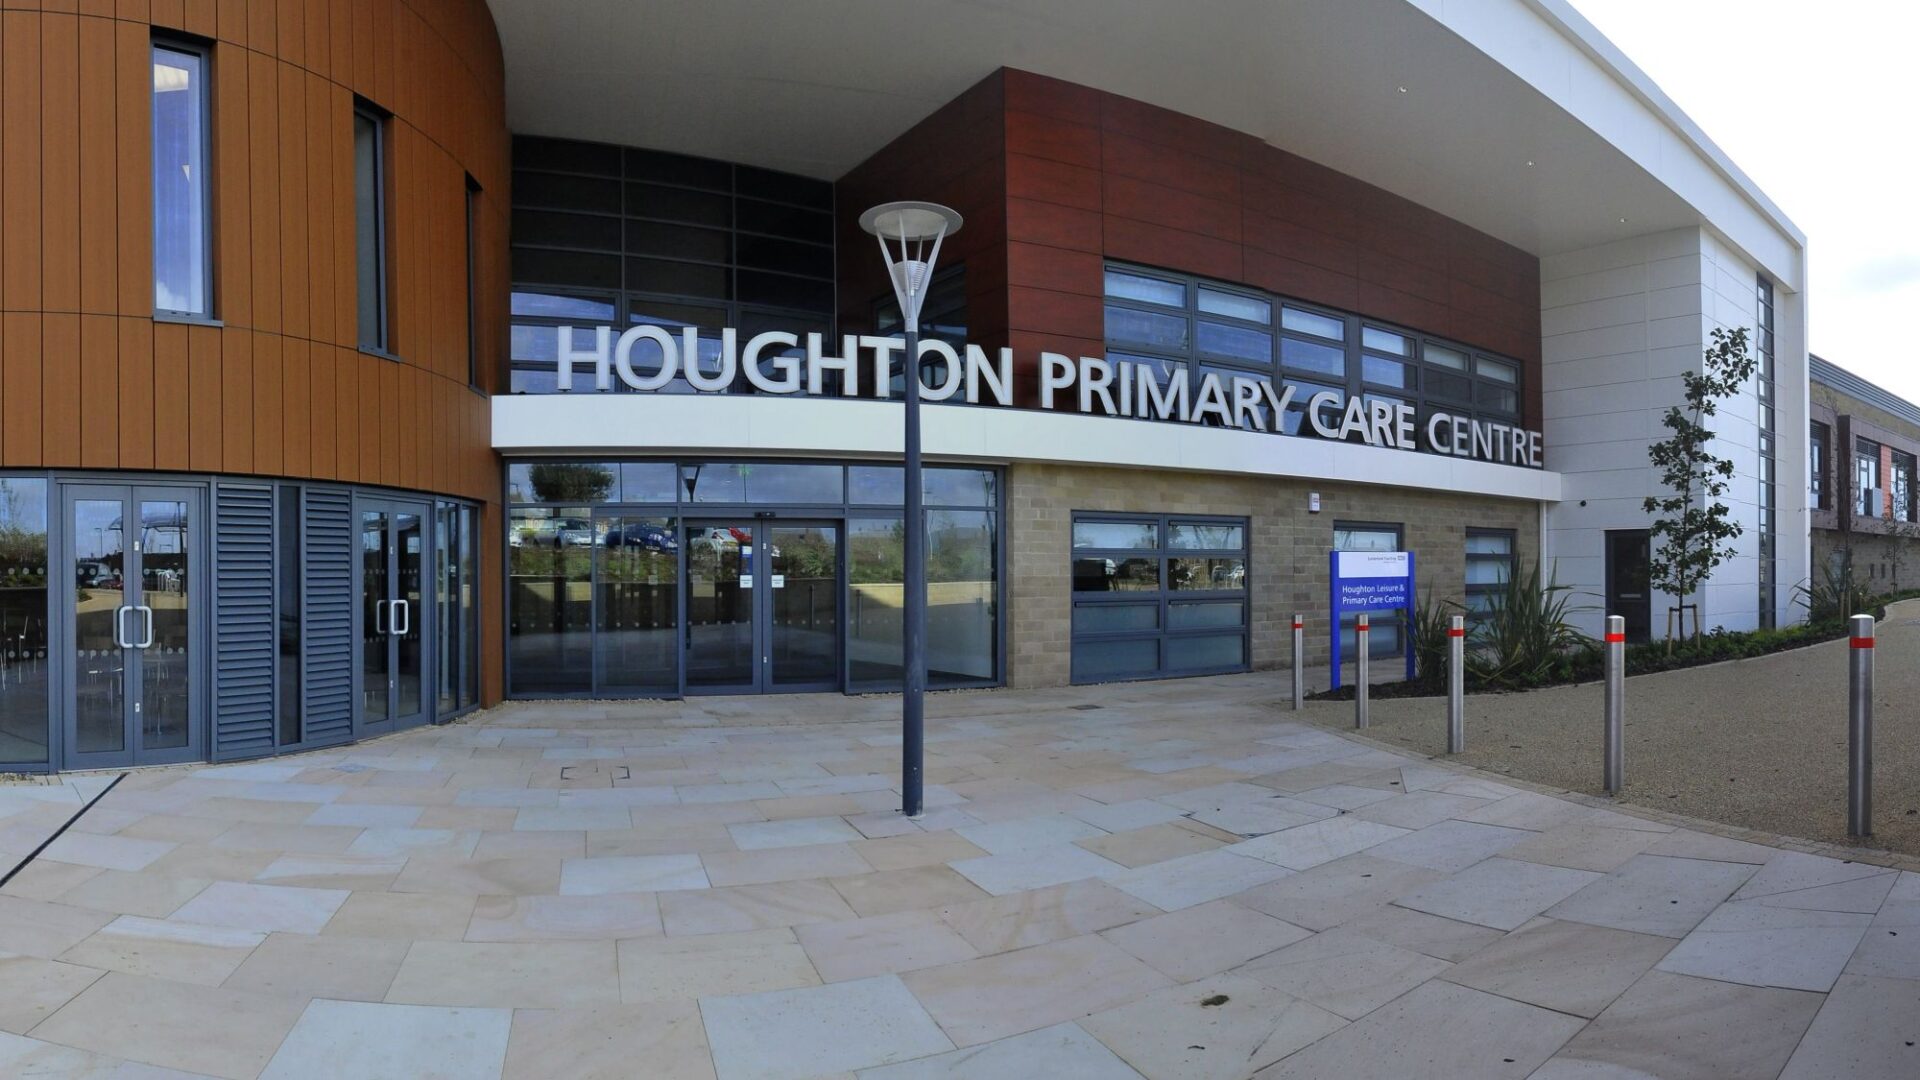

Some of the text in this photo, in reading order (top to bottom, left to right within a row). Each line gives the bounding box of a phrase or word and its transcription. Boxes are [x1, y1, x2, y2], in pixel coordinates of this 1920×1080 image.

[557, 324, 1543, 468] HOUGHTON PRIMARY CARE CENTRE
[1342, 584, 1404, 594] Houghton Leisure &
[1342, 596, 1367, 605] Primary
[1368, 595, 1383, 603] Care
